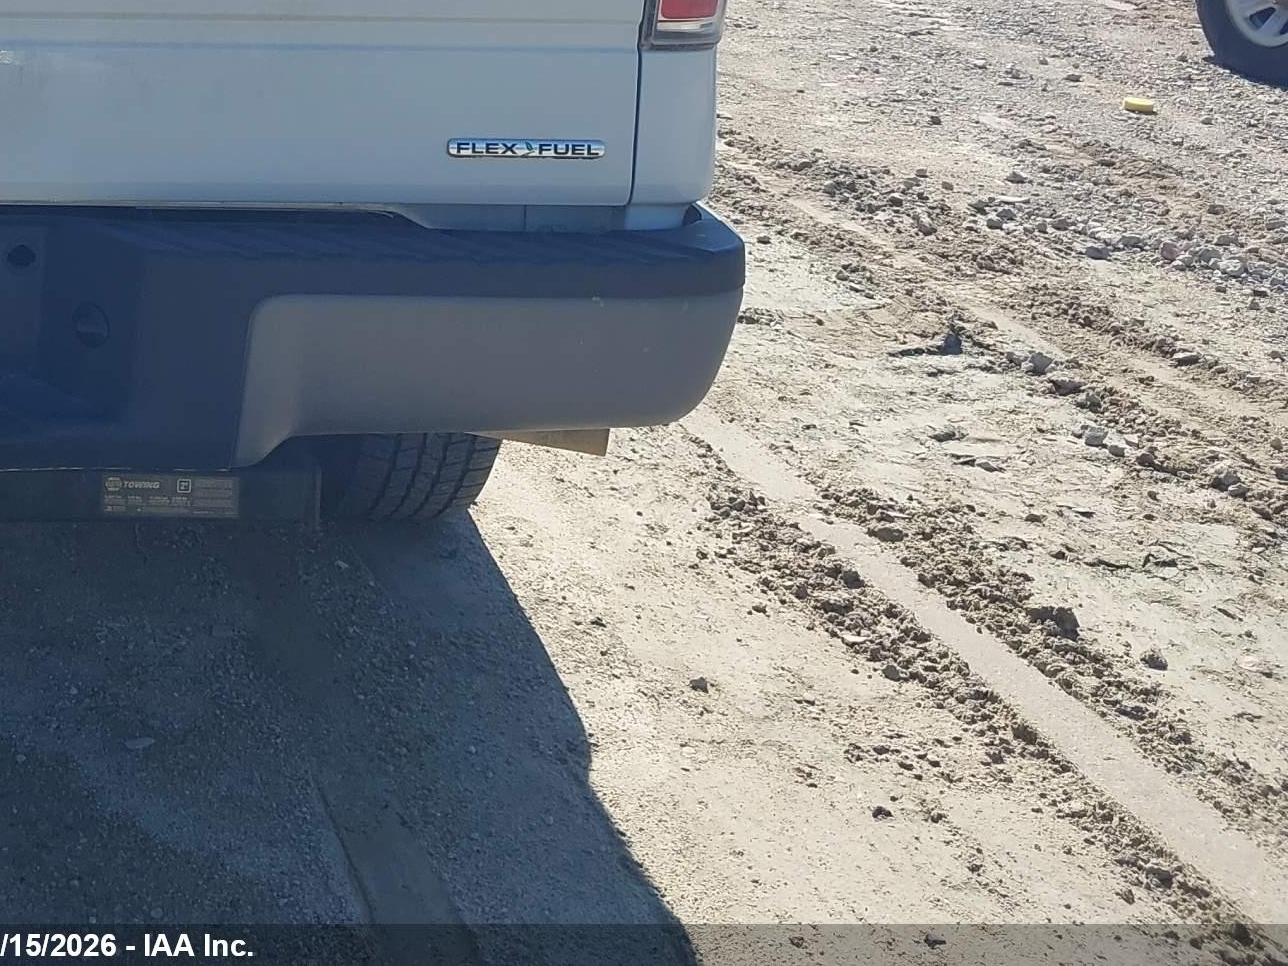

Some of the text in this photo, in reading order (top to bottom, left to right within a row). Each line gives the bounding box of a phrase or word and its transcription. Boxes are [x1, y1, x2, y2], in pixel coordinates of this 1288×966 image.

[456, 142, 600, 156] FLEX FUEL
[123, 480, 161, 489] TOWING
